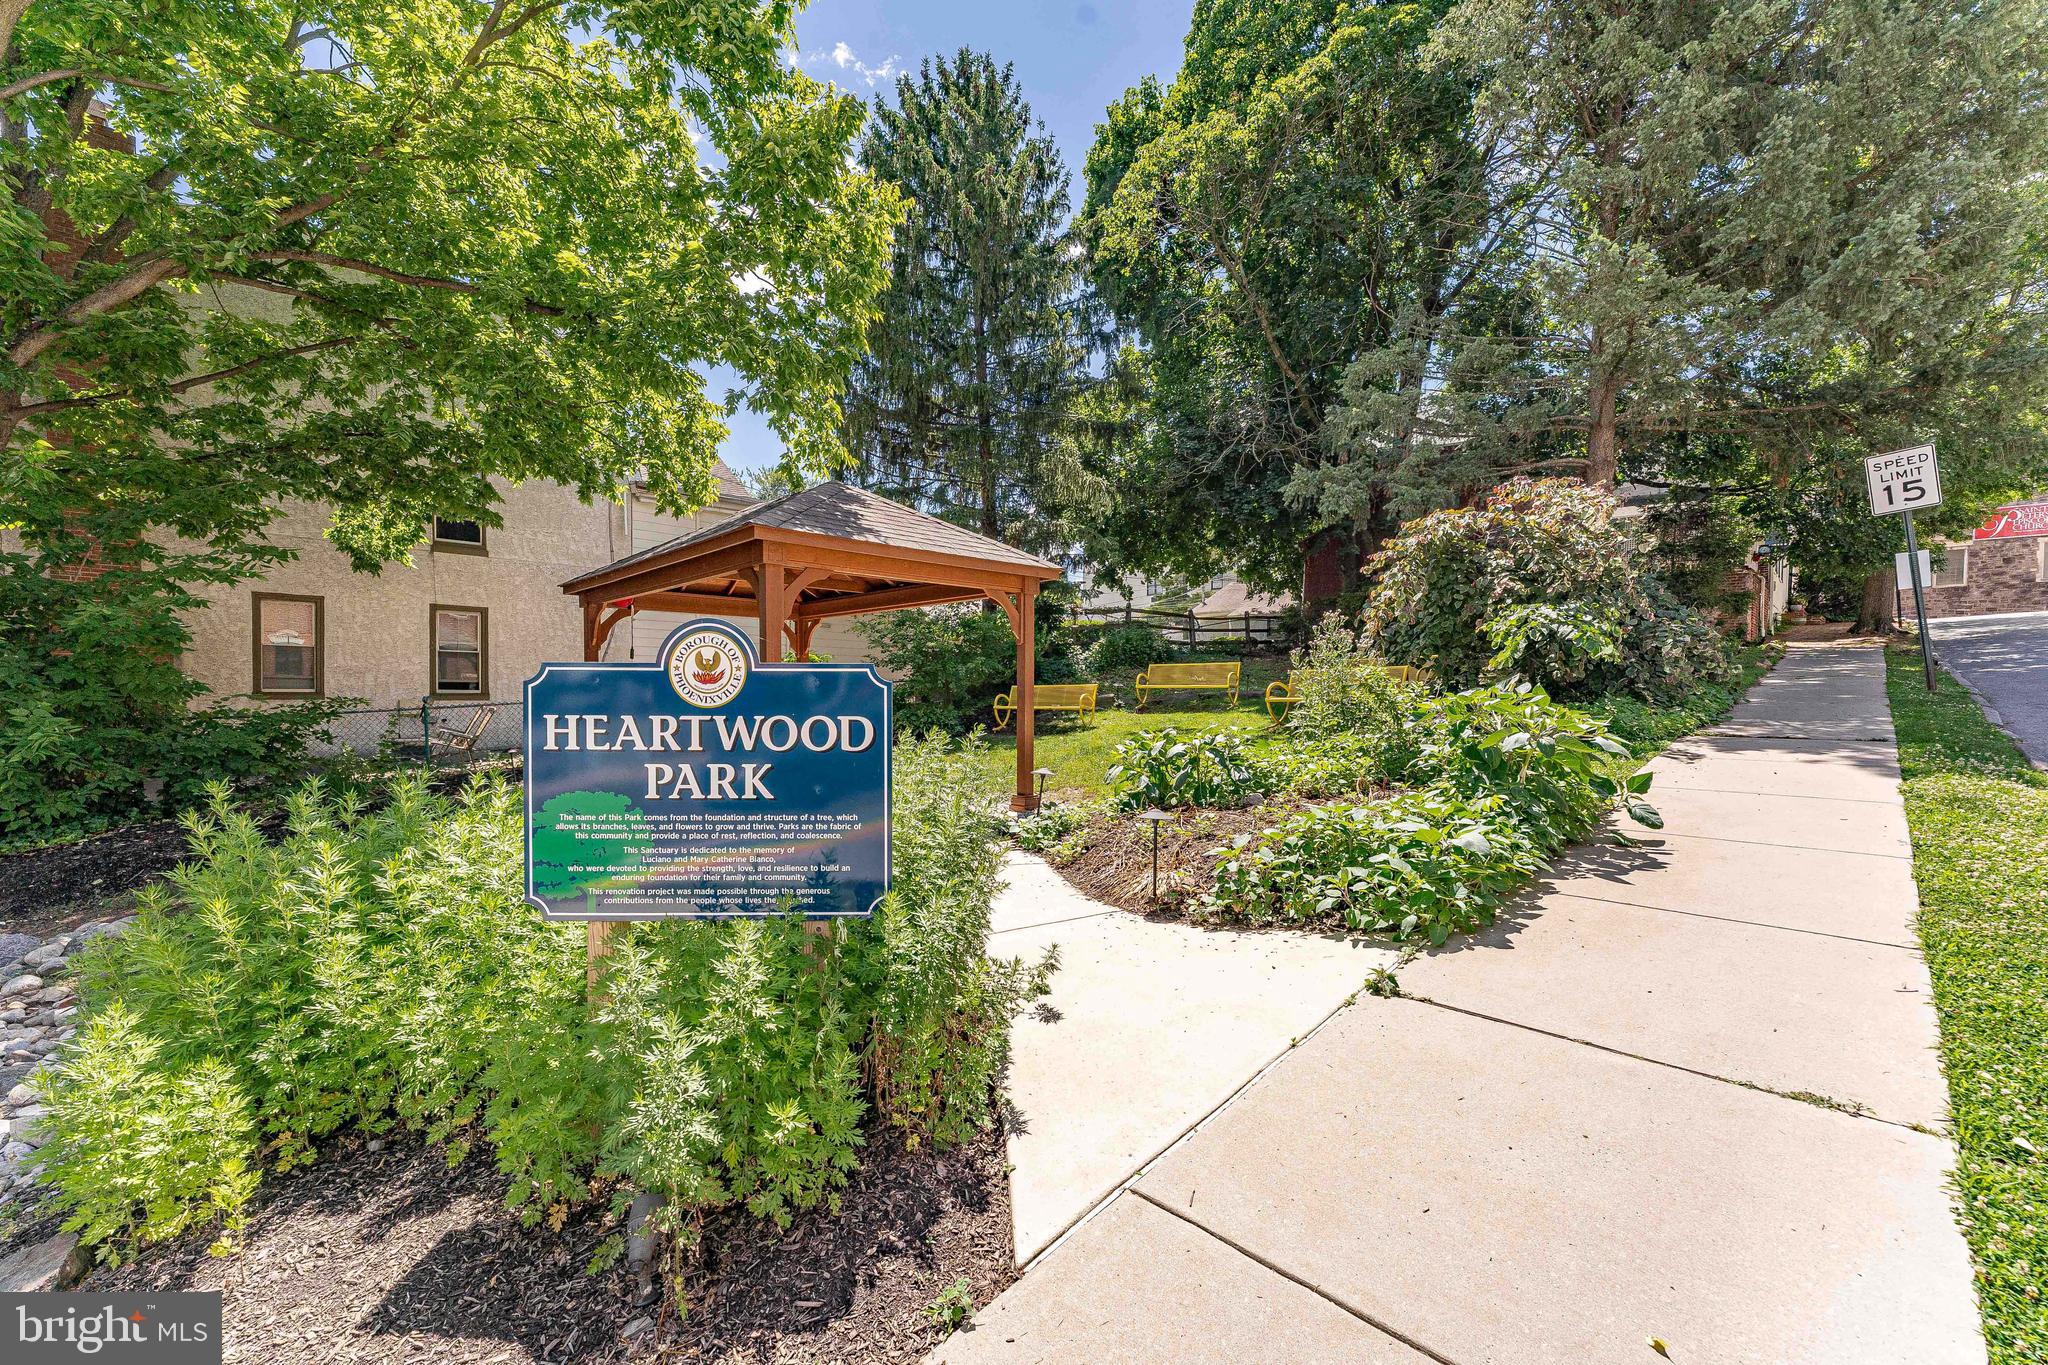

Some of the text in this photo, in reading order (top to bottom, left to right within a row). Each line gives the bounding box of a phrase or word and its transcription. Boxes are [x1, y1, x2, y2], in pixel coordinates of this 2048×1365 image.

[1873, 453, 1929, 472] SPEED
[1880, 465, 1923, 483] LIMIT
[1883, 478, 1926, 505] 15
[675, 635, 741, 664] BOROUGH OF
[674, 672, 742, 704] PHOENIXVILLE
[543, 714, 875, 752] HEARTWOOD
[644, 763, 775, 800] PARK
[817, 814, 834, 822] tree,
[593, 823, 629, 831] branches,
[631, 823, 657, 831] leaves,
[591, 832, 632, 840] community
[651, 832, 680, 840] provide
[689, 832, 709, 840] place
[721, 832, 738, 840] rest,
[740, 832, 778, 840] reflection,
[640, 847, 679, 855] Sanctuary
[691, 856, 708, 864] Mary
[749, 856, 776, 864] Bianco,
[650, 865, 685, 873] providing
[702, 865, 736, 873] strength,
[738, 865, 755, 873] love,
[611, 874, 644, 882] enduring
[723, 874, 746, 882] family
[764, 874, 807, 882] community.
[647, 888, 674, 896] project
[716, 888, 748, 896] possible
[750, 888, 780, 896] through
[690, 897, 717, 905] people
